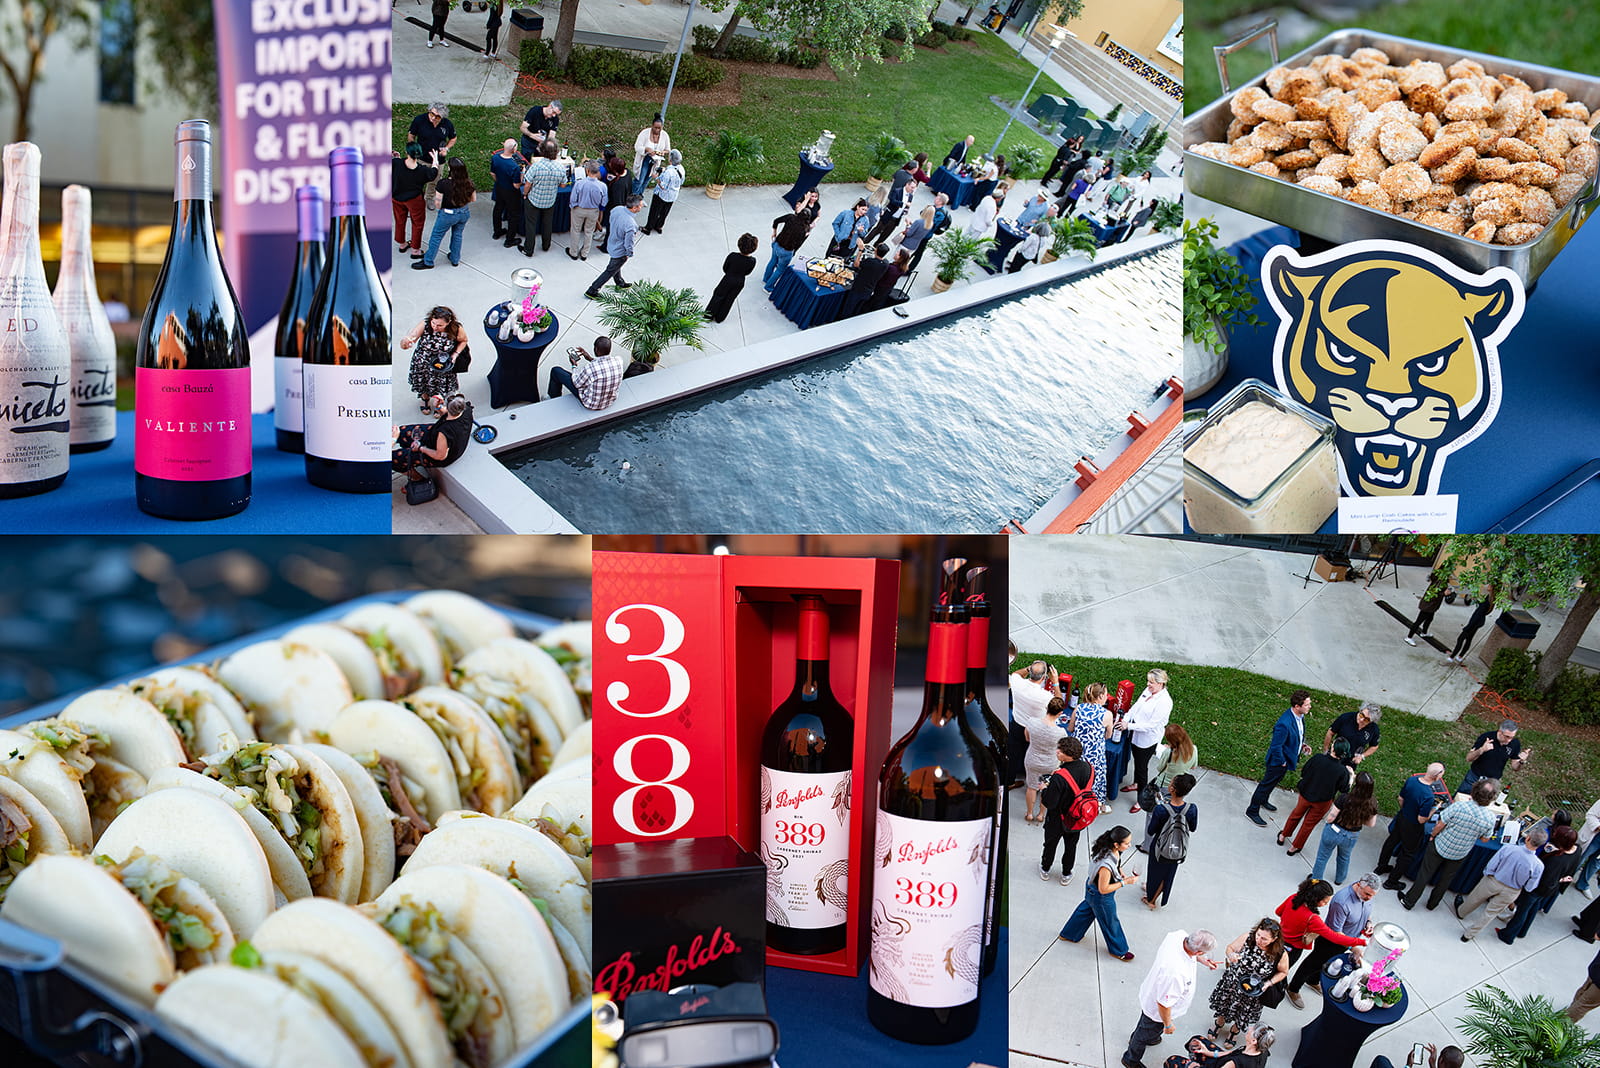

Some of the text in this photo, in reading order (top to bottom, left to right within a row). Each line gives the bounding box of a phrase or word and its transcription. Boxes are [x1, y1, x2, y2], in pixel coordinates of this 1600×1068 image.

[255, 28, 392, 75] IMPORT
[235, 80, 305, 119] FOR
[306, 74, 378, 115] THE
[254, 117, 392, 161] & FLORI
[162, 384, 214, 393] casa Bauzá
[145, 418, 237, 433] VALIENTE
[775, 785, 823, 810] Penfolds
[775, 820, 826, 847] 389
[898, 836, 958, 865] Penfolds
[895, 876, 958, 909] 389
